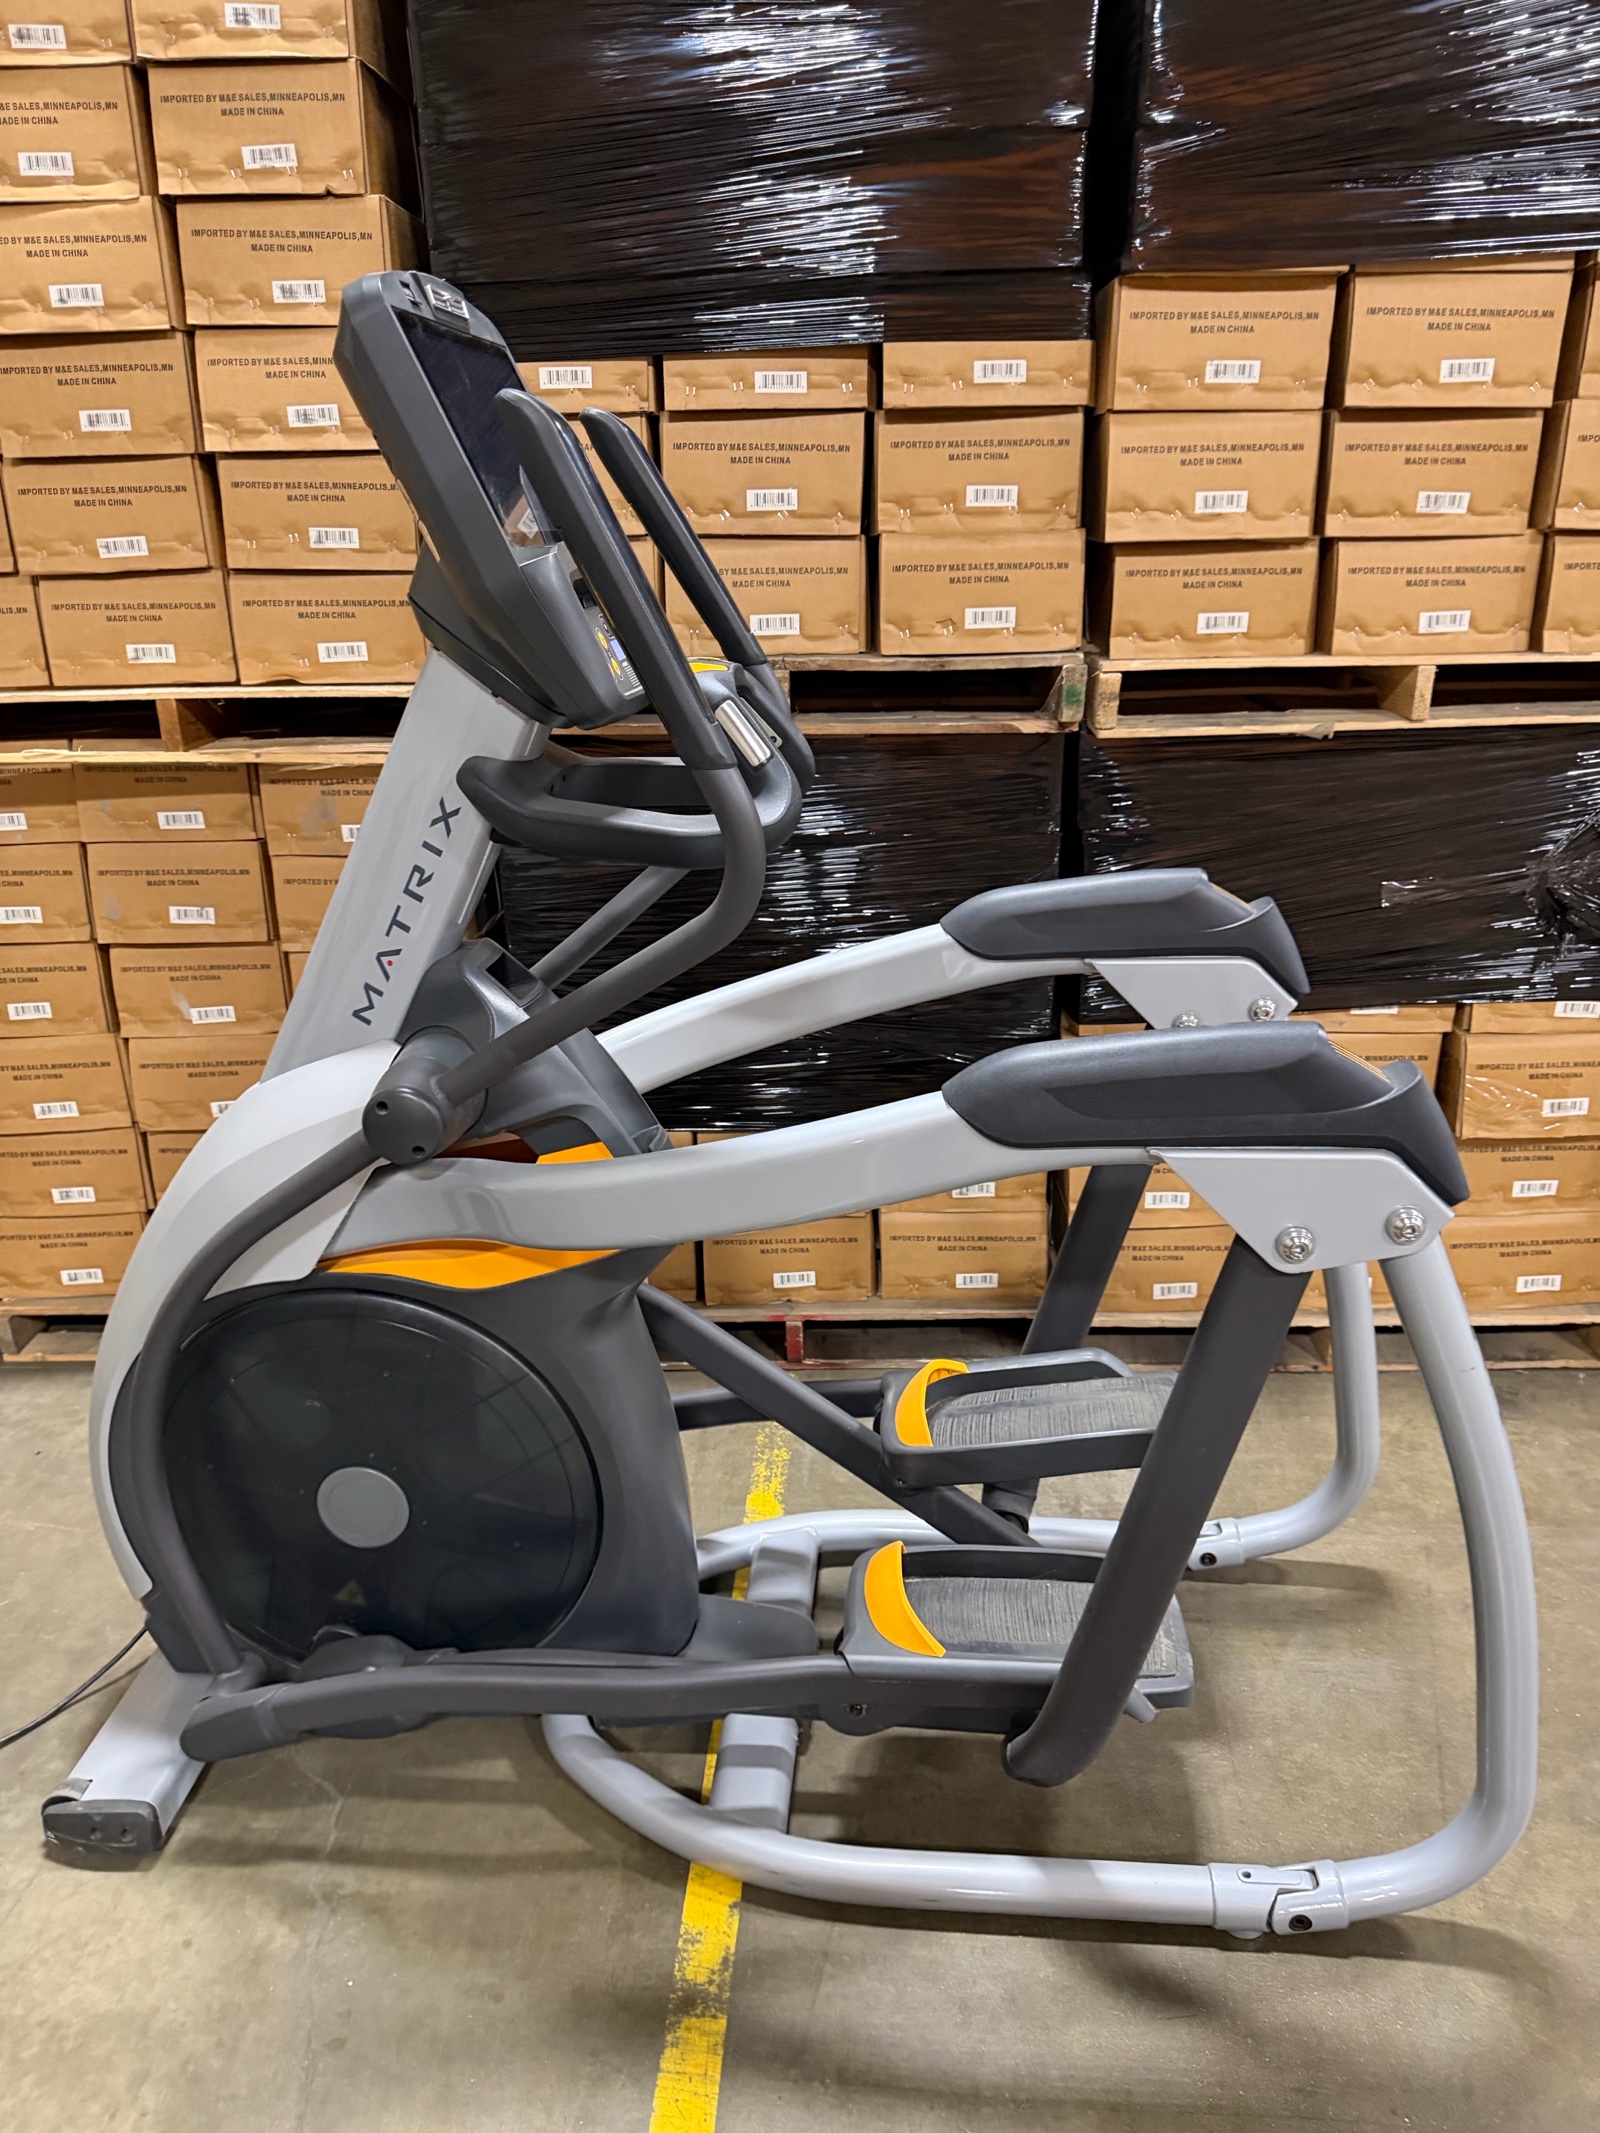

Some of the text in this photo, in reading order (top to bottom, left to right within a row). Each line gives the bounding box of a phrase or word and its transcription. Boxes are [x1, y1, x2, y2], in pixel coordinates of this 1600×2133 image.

[160, 95, 204, 103] IMPORTED
[219, 94, 237, 102] M&E
[221, 108, 244, 116] MADE
[191, 229, 234, 237] IMPORTED
[249, 230, 267, 238] M&E
[23, 236, 41, 244] M&E
[1366, 307, 1411, 315] IMPORTED
[1415, 308, 1426, 316] BY
[1427, 308, 1446, 316] M&E
[1178, 312, 1188, 320] BY
[948, 440, 965, 448] M&E
[1180, 445, 1198, 453] M&E
[1180, 458, 1203, 466] MADE
[1404, 457, 1427, 465] MADE
[719, 568, 729, 576] BY
[731, 567, 748, 577] M&E
[1171, 569, 1180, 577] BY
[129, 614, 137, 622] IN
[352, 796, 462, 1025] MATRIX
